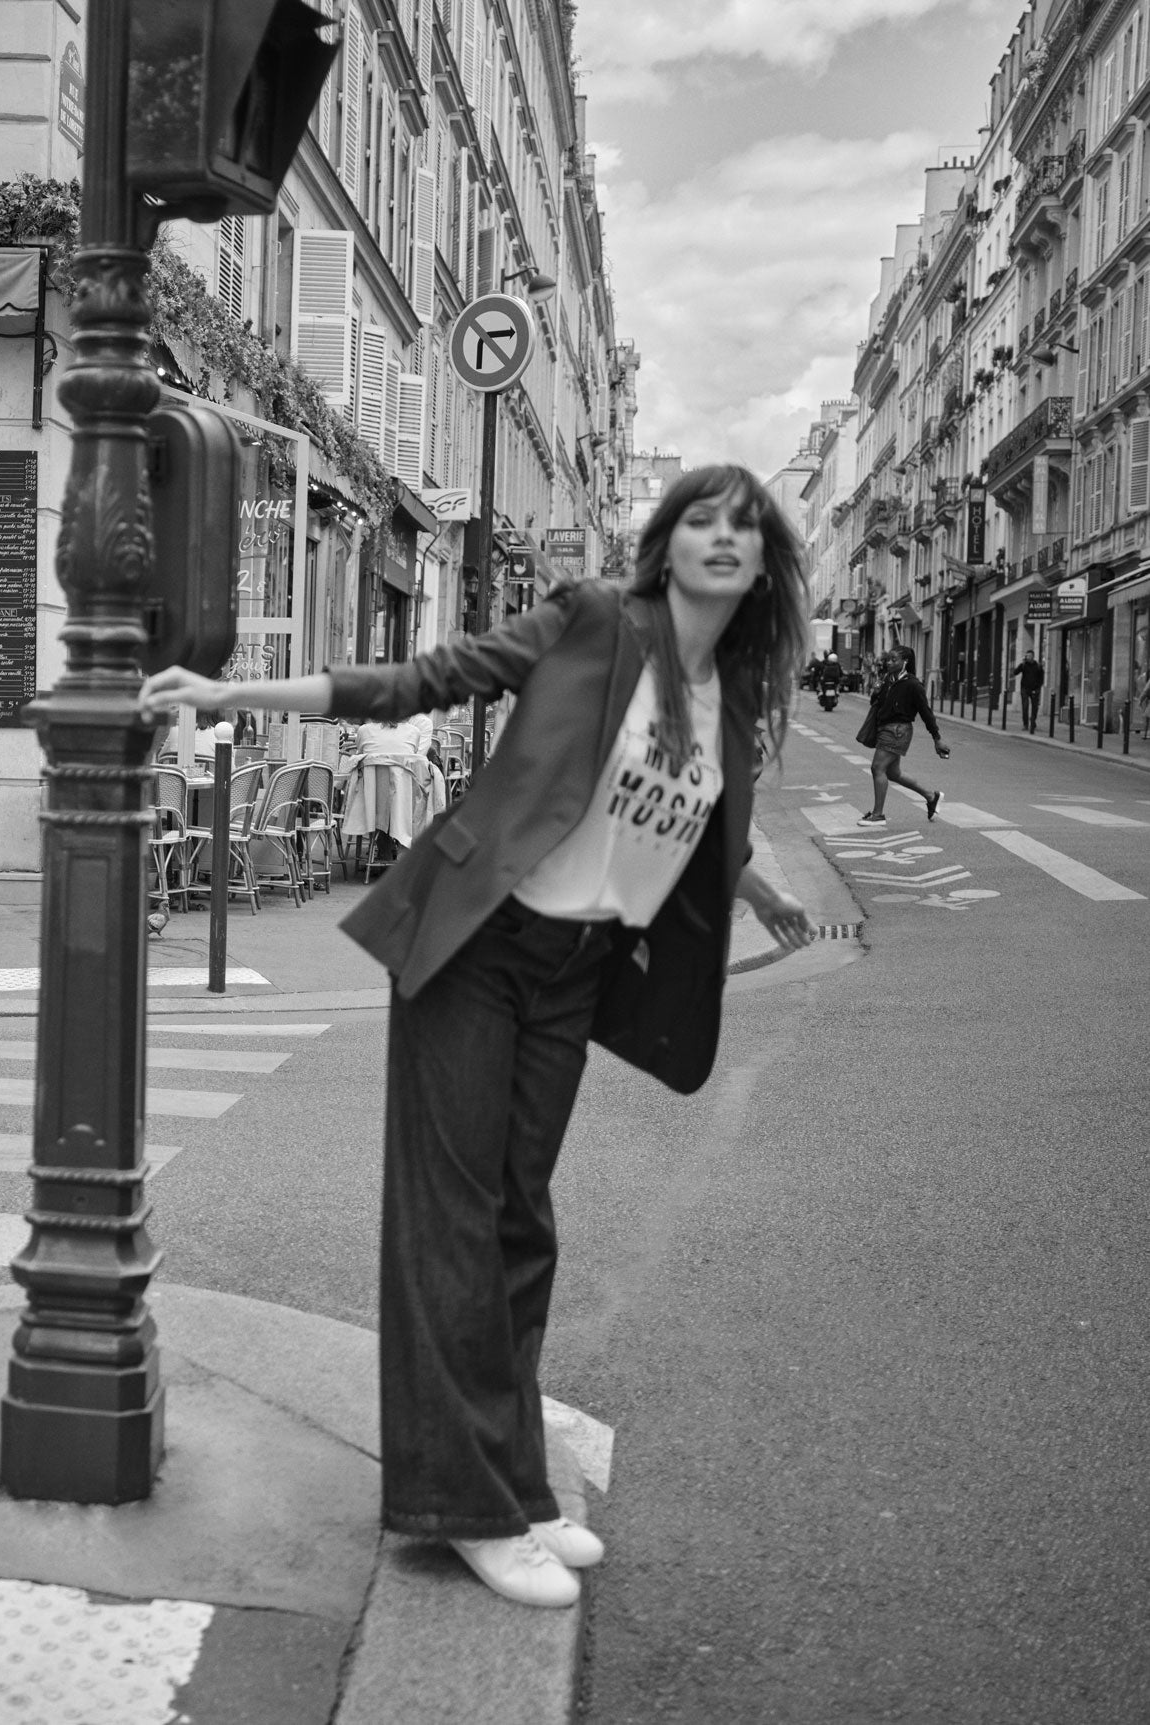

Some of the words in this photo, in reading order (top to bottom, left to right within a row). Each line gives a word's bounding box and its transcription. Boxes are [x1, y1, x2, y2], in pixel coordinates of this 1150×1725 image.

[238, 499, 293, 519] NCHE
[548, 531, 585, 542] LAVERIE
[971, 506, 982, 554] HOTEL
